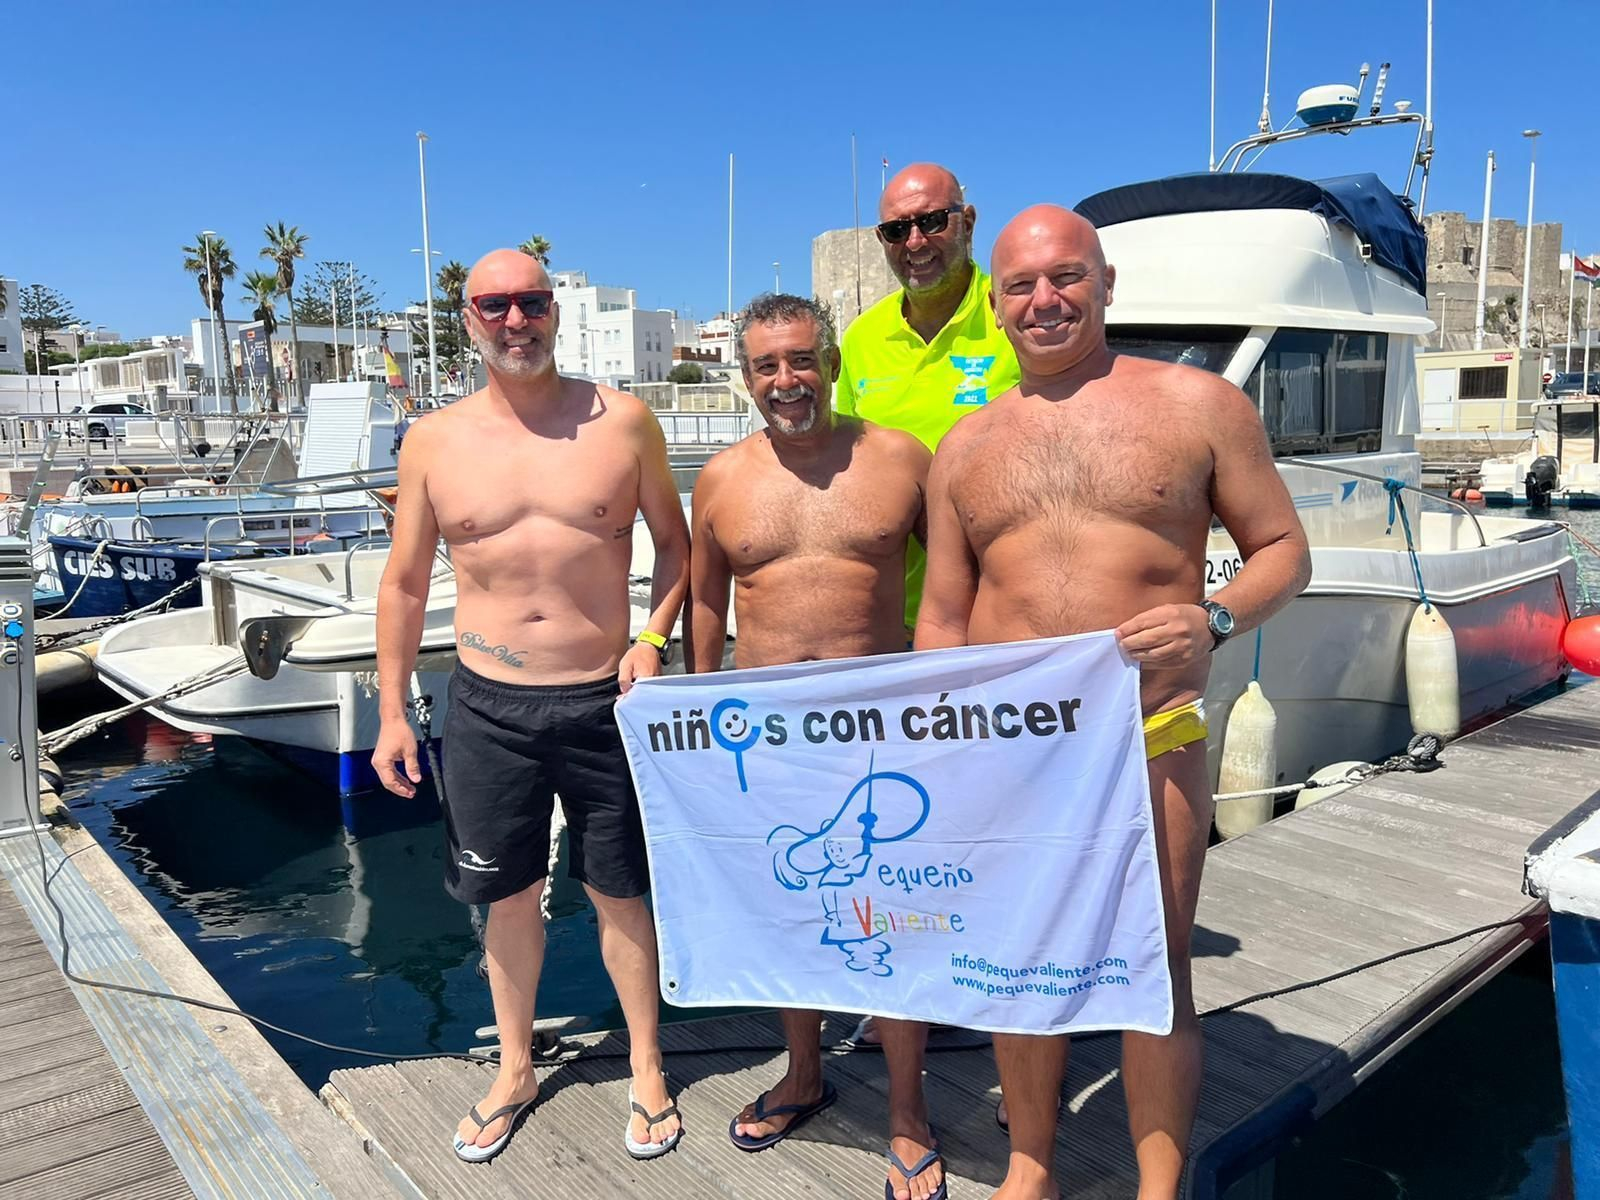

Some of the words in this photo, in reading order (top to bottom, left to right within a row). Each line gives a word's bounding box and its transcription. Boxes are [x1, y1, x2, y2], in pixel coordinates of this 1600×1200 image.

[120, 556, 177, 581] SUB
[803, 708, 886, 744] con
[901, 693, 1082, 741] cáncer
[852, 896, 966, 938] Valiente
[951, 953, 1128, 981] info@pequevaliente.com
[952, 973, 1131, 997] www.pequevaliente.com
